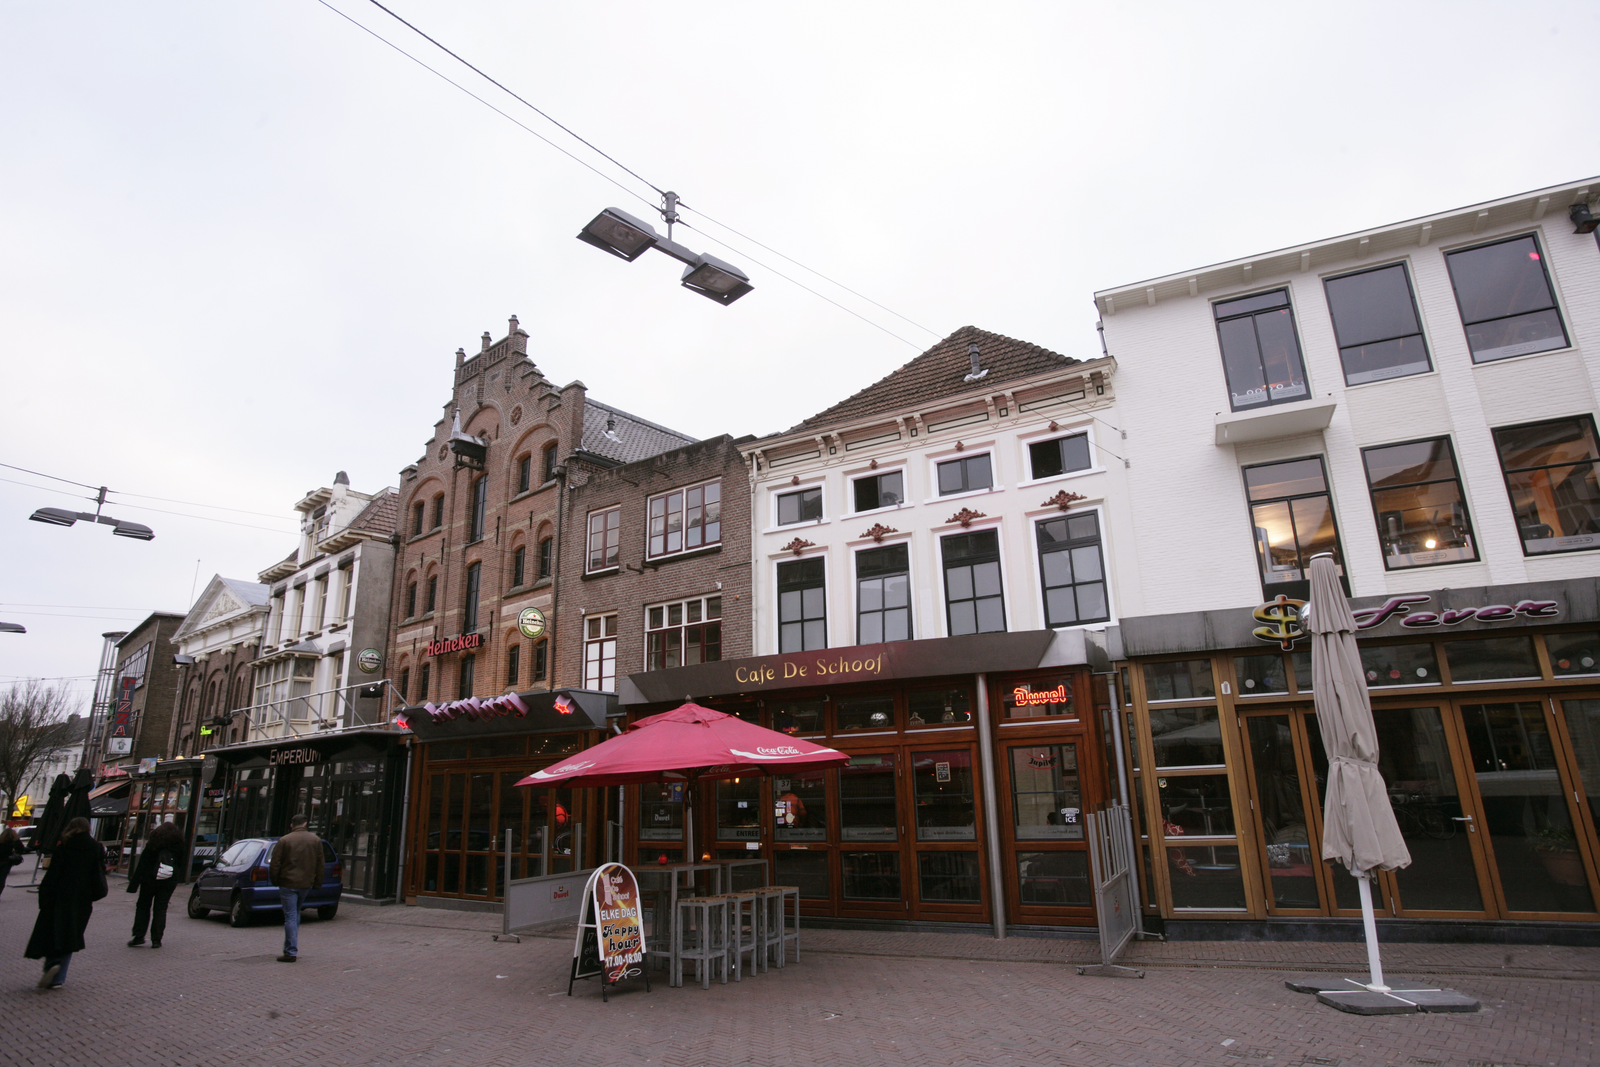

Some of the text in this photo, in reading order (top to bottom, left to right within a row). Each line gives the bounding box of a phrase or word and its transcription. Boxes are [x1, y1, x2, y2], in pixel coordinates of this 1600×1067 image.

[427, 633, 479, 656] Heineken
[735, 652, 884, 685] Cafe De Schoof
[1013, 685, 1066, 706] Duvel
[113, 677, 136, 736] PIZZA
[270, 748, 322, 766] EMPERIUM
[756, 746, 799, 755] Coca-Cola
[553, 889, 570, 899] Duvel
[601, 907, 637, 921] ELKE DAG
[602, 923, 639, 938] Happy
[608, 938, 639, 952] hour
[605, 952, 642, 968] 17.00-18.00
